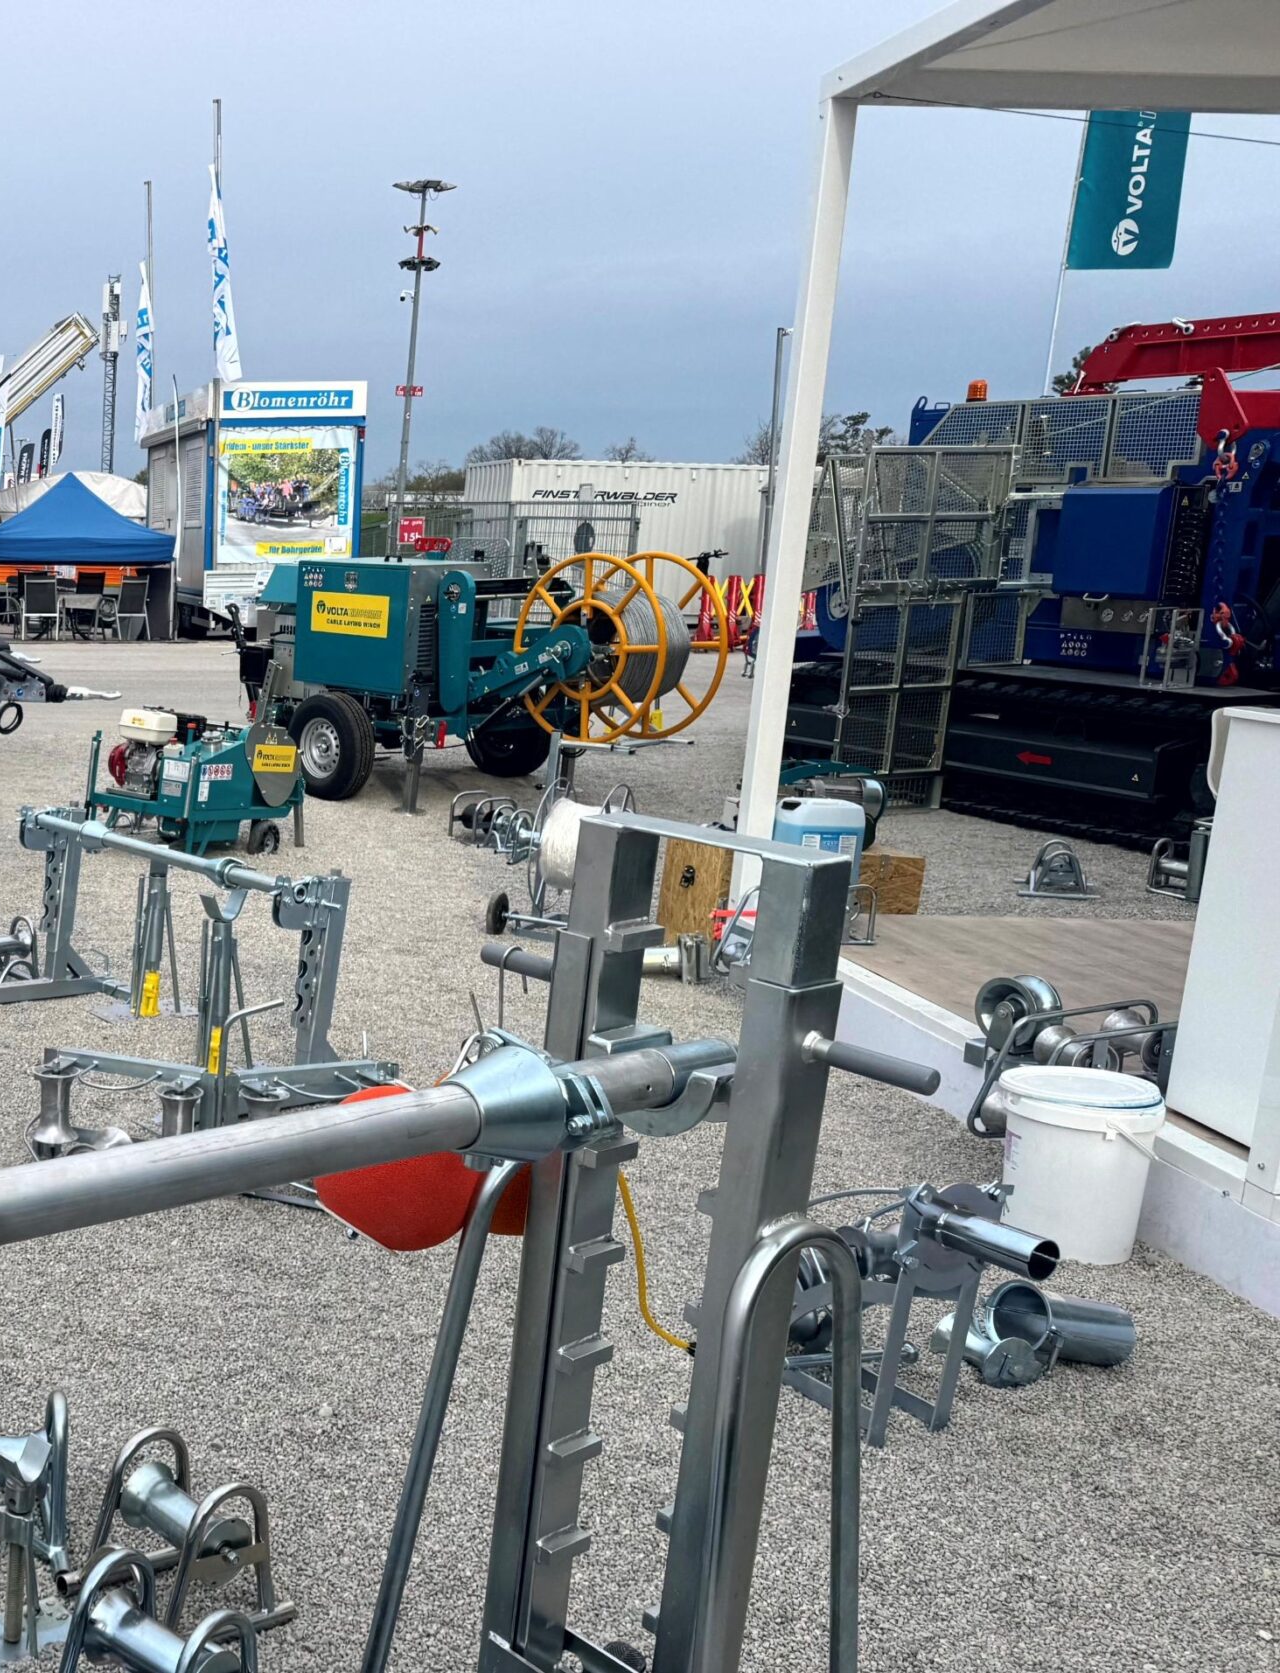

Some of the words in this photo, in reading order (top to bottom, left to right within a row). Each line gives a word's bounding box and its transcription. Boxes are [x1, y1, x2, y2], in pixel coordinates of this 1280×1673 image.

[1126, 124, 1155, 214] VOLTA
[235, 389, 350, 410] Blomenröhr
[532, 489, 679, 504] FINSTRWALDER
[326, 606, 349, 616] VOLTA
[326, 618, 343, 626] CABLE
[343, 619, 362, 627] LAYING
